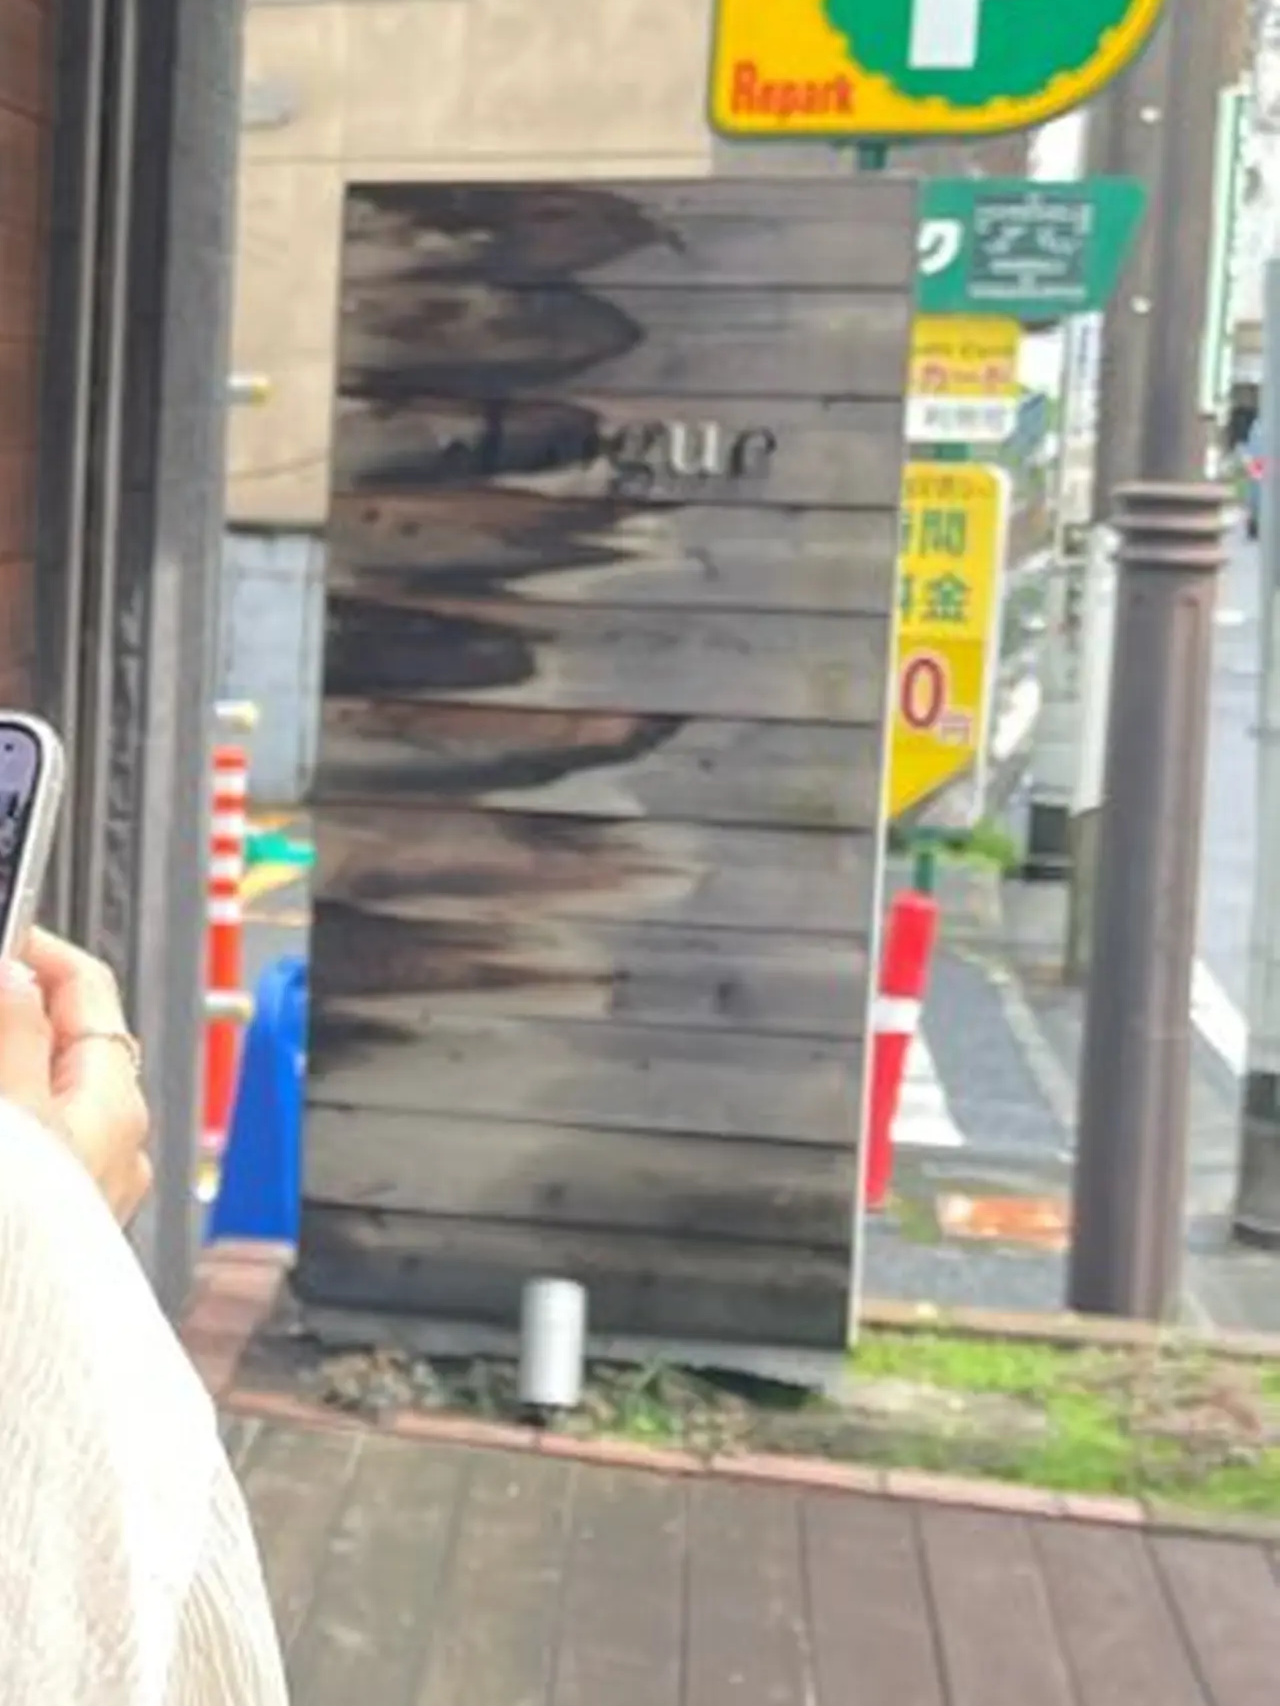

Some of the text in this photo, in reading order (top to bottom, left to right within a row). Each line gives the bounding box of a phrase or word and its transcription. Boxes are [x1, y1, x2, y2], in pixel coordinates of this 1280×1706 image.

[731, 60, 854, 127] Repark
[902, 509, 966, 557] 間
[901, 575, 967, 624] 金
